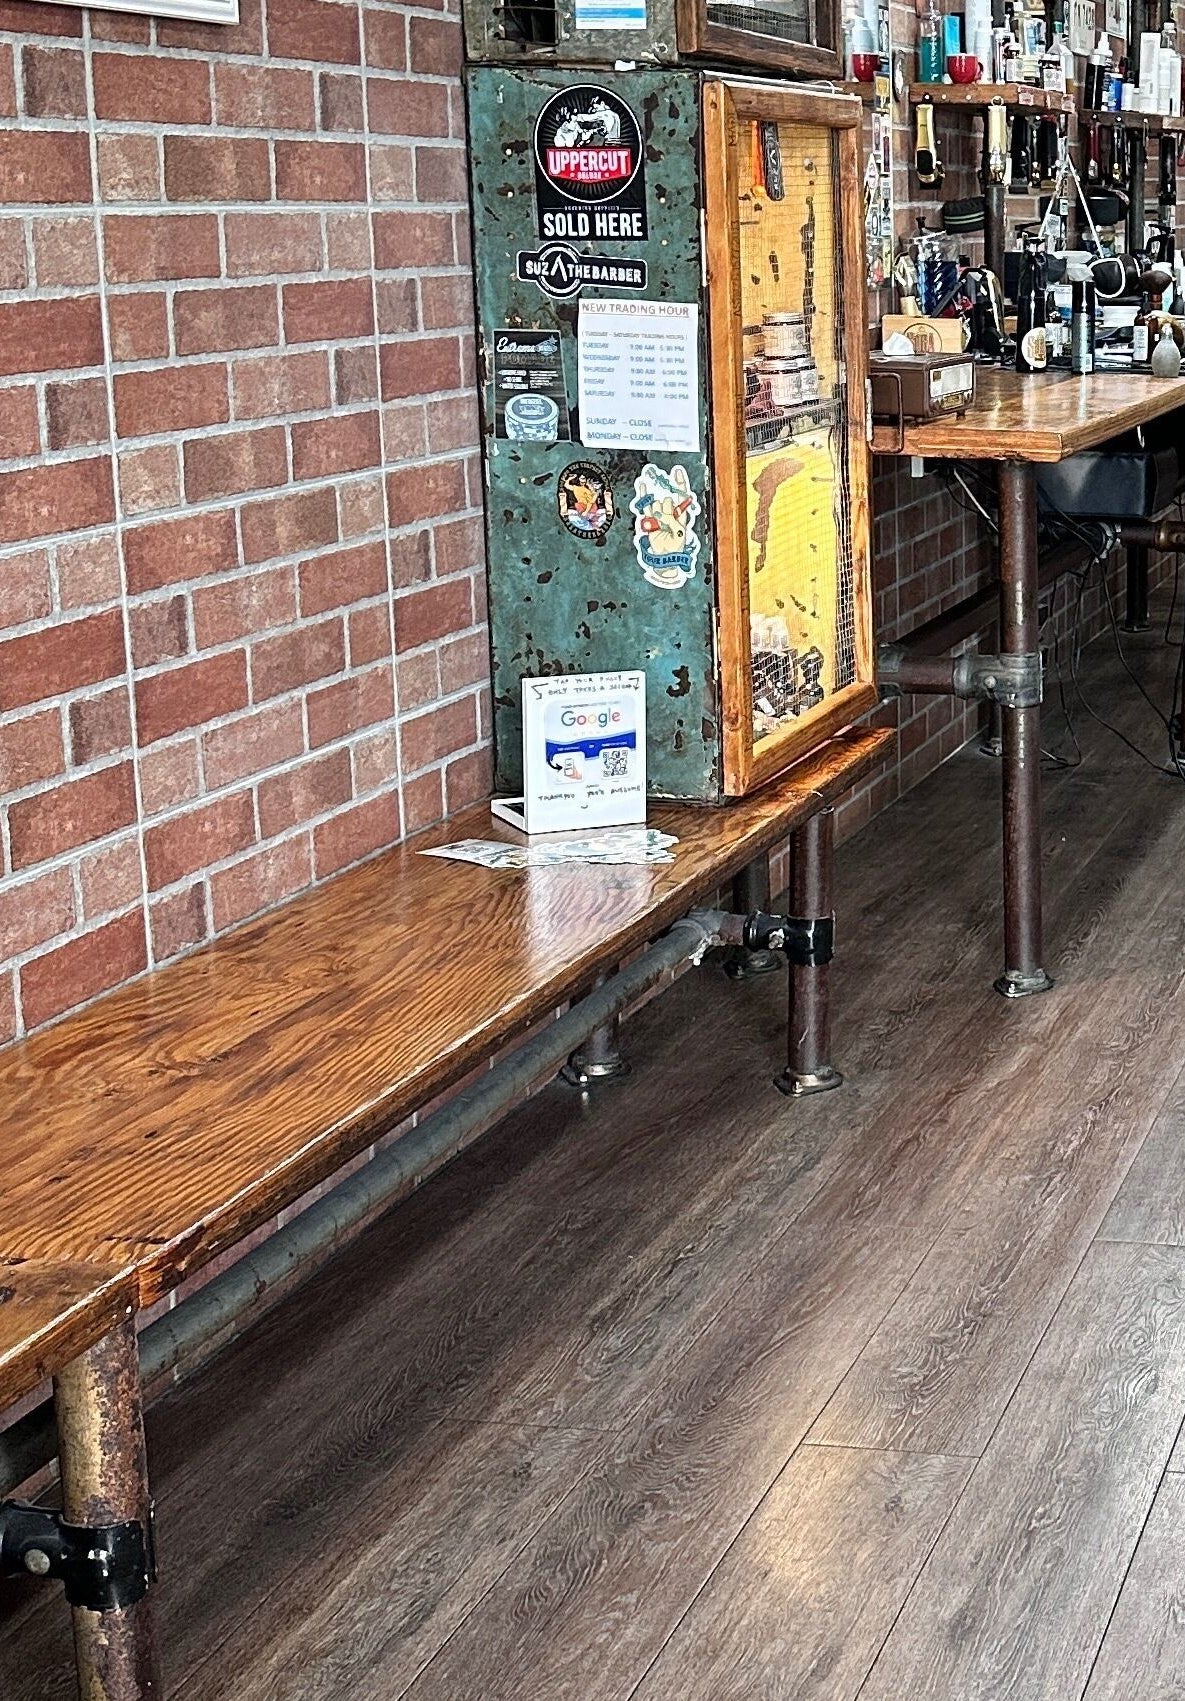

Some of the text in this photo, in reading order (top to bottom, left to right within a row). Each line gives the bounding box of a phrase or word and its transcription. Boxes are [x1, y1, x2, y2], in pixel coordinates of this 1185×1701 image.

[548, 150, 629, 175] UPPERCUT
[543, 213, 643, 237] SOLD HERE
[526, 260, 549, 276] SUZ
[582, 303, 689, 316] NEW TRADING HOUR
[586, 417, 616, 425] SUNDAY
[629, 419, 653, 427] CLOSE
[587, 432, 621, 440] MONDAY
[561, 707, 621, 728] Google
